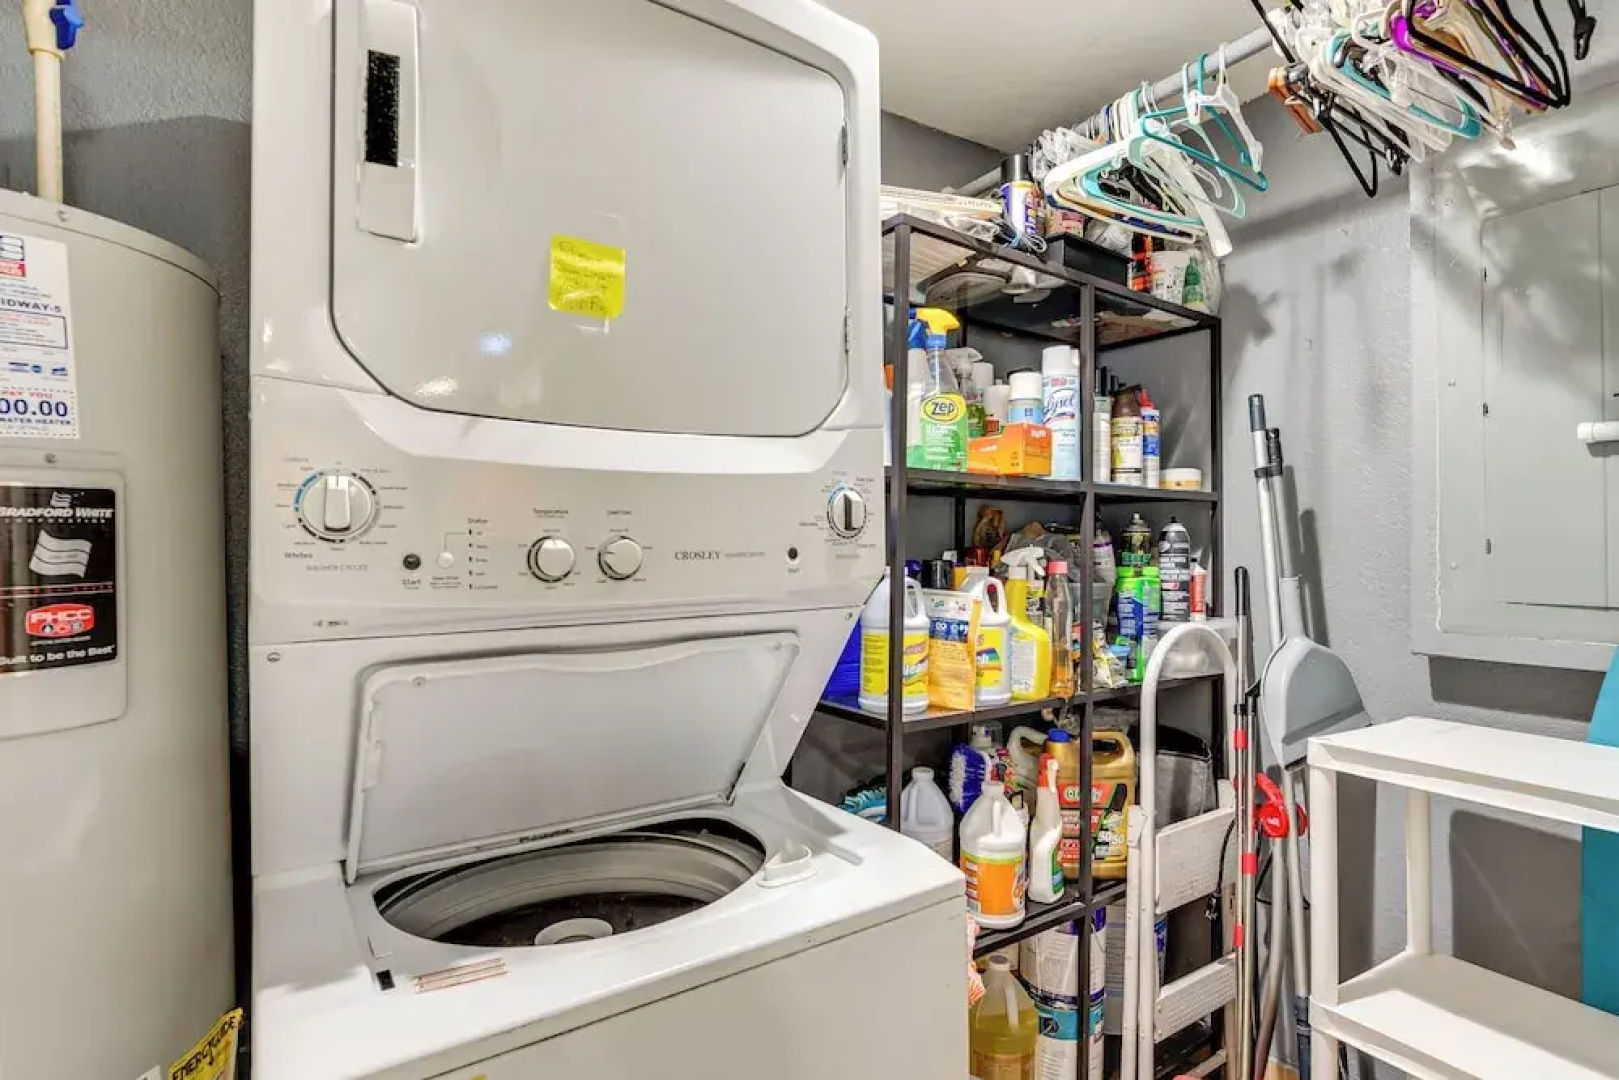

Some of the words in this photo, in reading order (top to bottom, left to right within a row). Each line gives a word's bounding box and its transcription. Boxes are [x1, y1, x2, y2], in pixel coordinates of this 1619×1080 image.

[0, 506, 74, 518] BRADFORD
[75, 507, 115, 519] WHITE
[674, 550, 721, 561] CROSLEY
[30, 653, 45, 663] to
[46, 651, 65, 662] be
[66, 649, 87, 659] the
